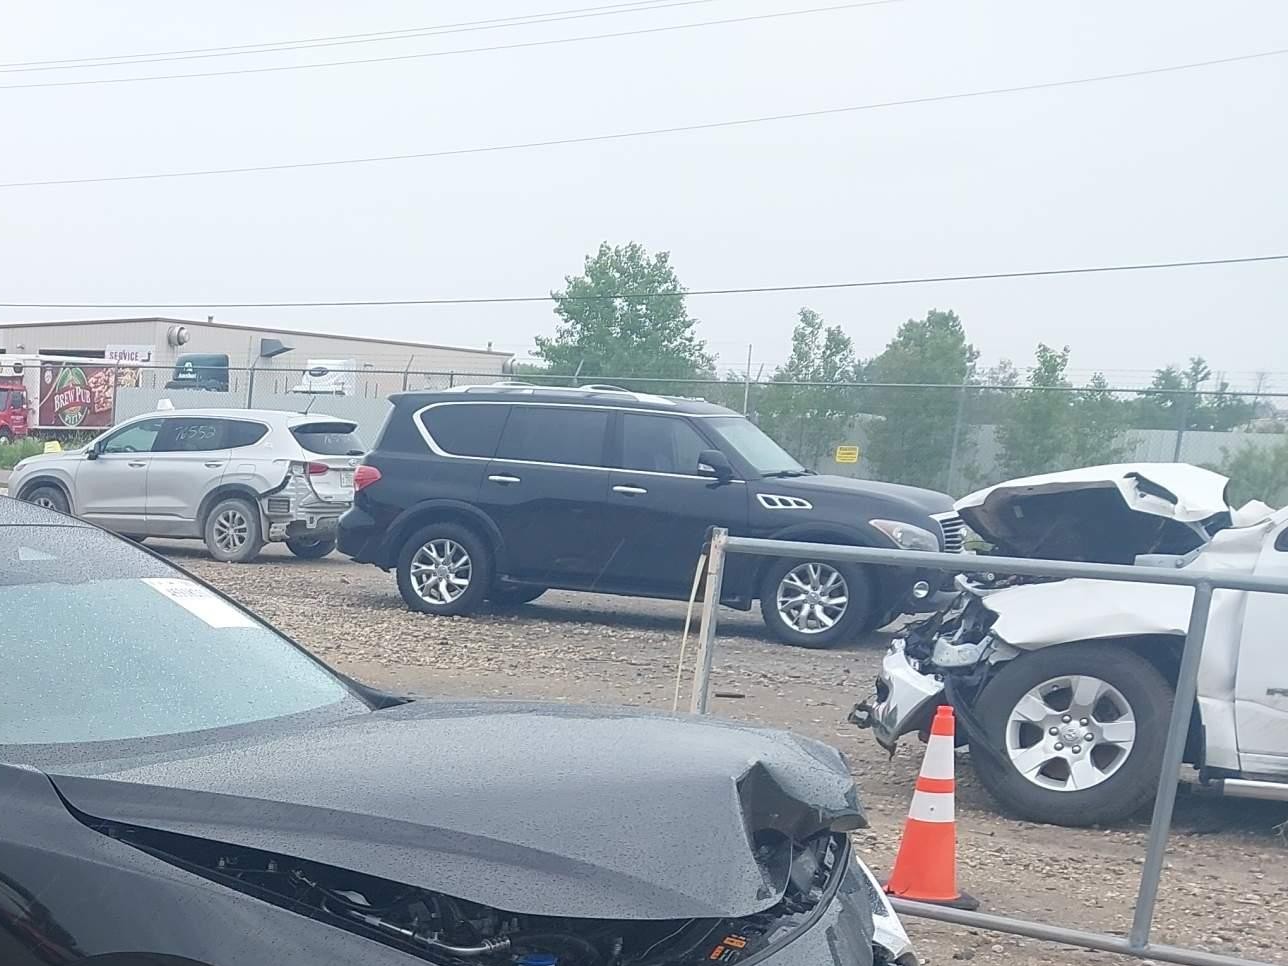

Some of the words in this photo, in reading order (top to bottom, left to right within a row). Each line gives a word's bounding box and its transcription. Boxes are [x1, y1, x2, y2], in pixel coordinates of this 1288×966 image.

[109, 351, 139, 361] SERVICE
[54, 389, 76, 412] BREW
[76, 386, 91, 404] PUB
